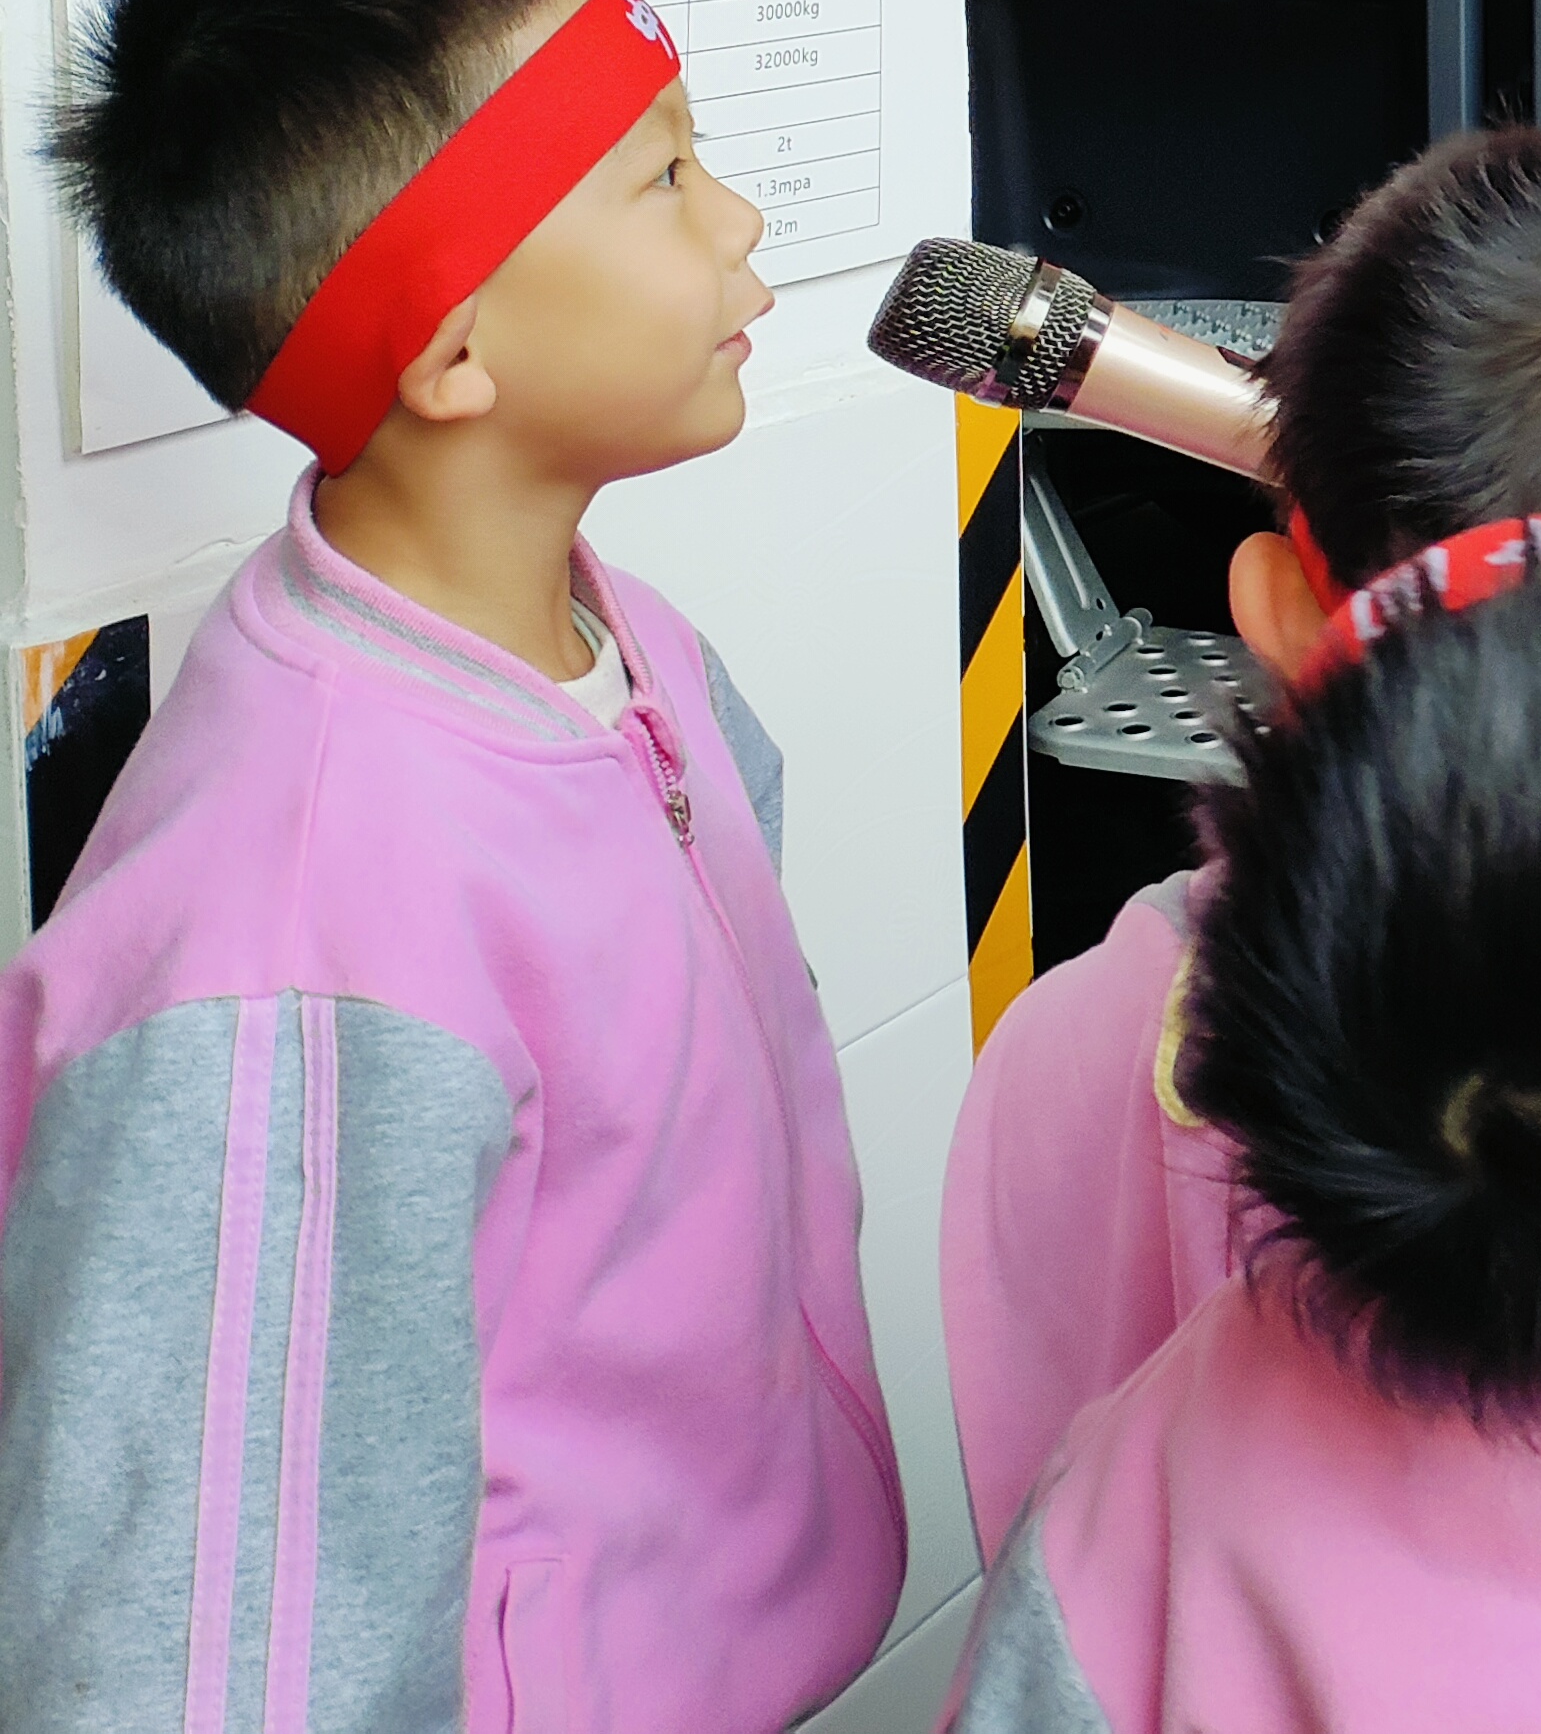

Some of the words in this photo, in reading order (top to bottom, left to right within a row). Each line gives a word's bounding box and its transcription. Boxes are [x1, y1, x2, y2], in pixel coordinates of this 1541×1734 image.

[756, 0, 820, 22] 30000kg
[755, 47, 819, 71] 32000kg
[777, 135, 792, 153] 2t
[756, 175, 812, 199] 1.3mpa
